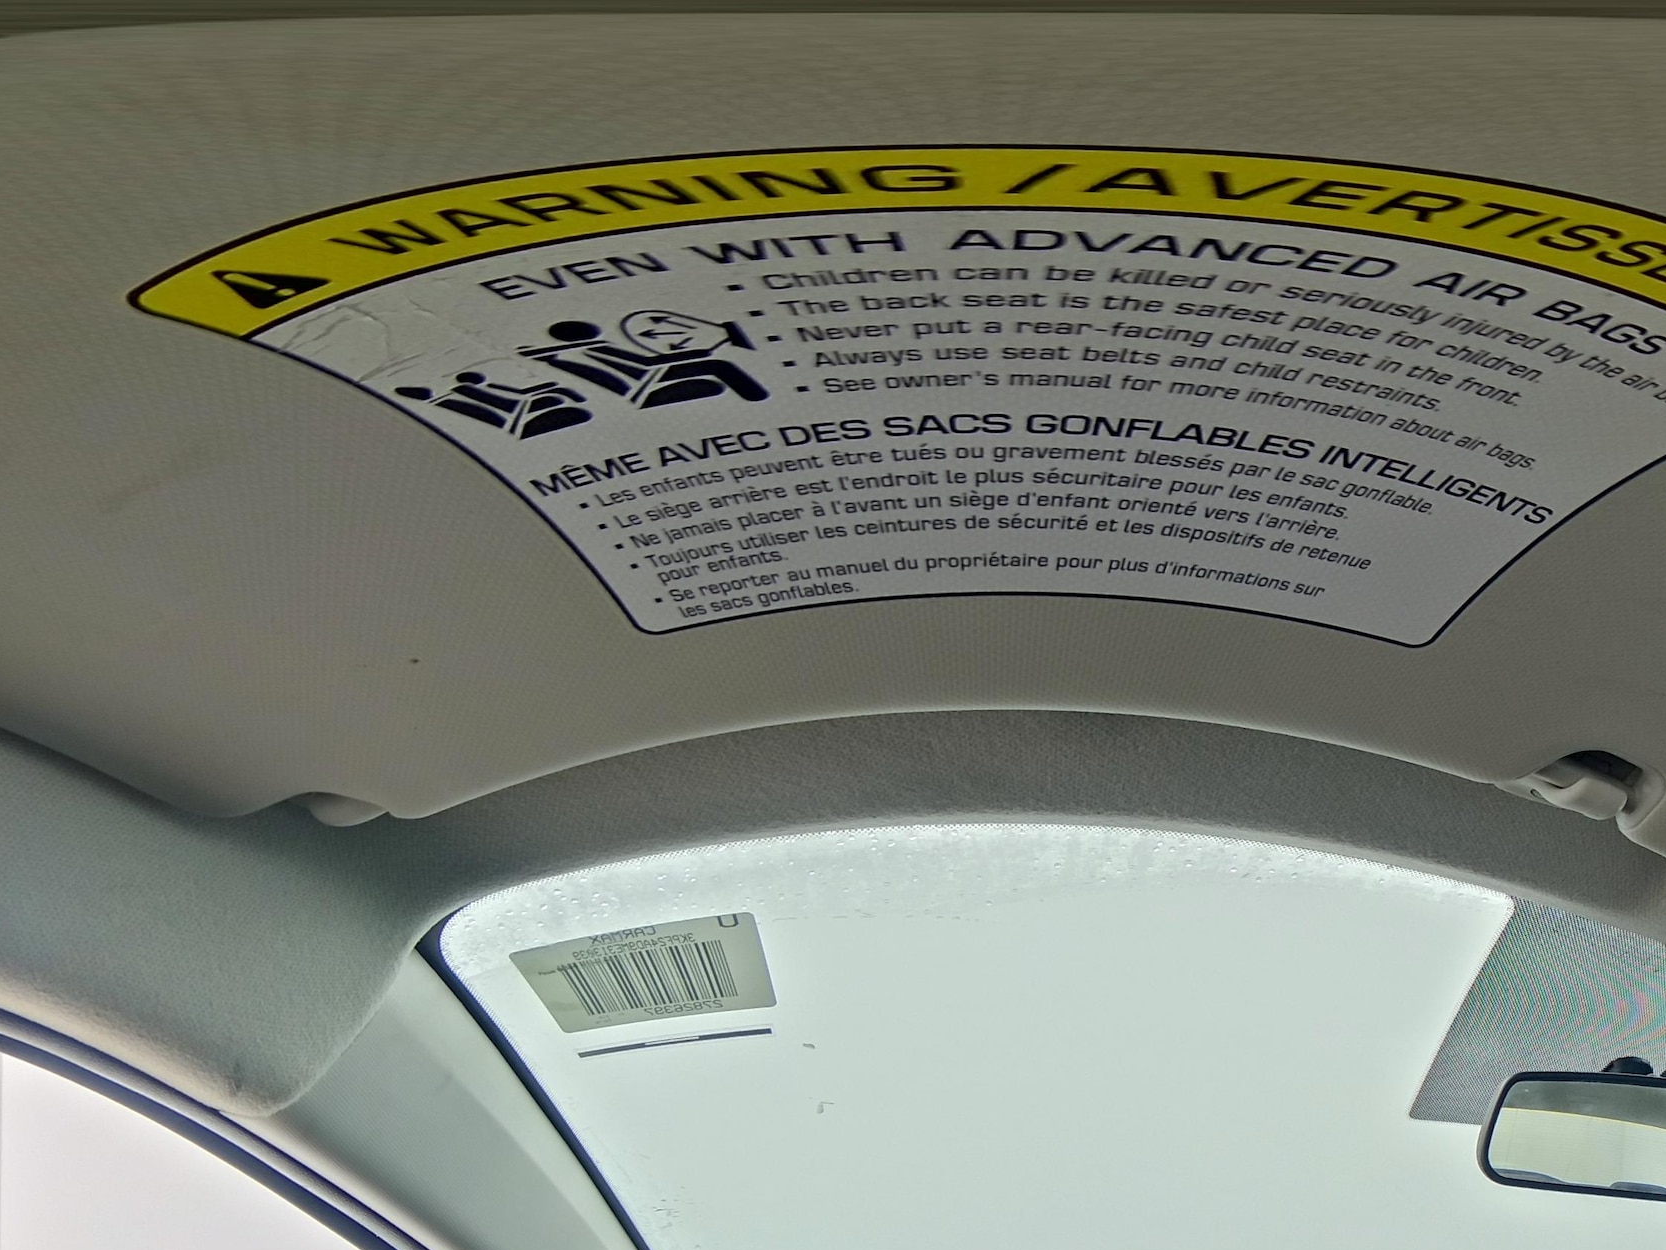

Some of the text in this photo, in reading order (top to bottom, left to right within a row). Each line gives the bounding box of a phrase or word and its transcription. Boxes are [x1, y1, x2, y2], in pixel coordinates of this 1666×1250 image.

[326, 164, 963, 256] WARNING
[477, 252, 671, 301] EVEN
[681, 231, 906, 265] WITH
[946, 229, 1399, 279] ADVANCED
[1411, 271, 1528, 307] AIR
[760, 268, 939, 291] Children
[951, 267, 1029, 281] can
[1043, 265, 1097, 282] be
[1107, 267, 1219, 290] killed
[1223, 279, 1273, 295] or
[1277, 286, 1443, 326] seriously
[1439, 313, 1551, 351] injured
[1542, 342, 1584, 364] by
[1578, 355, 1626, 379] the
[1620, 374, 1660, 391] air
[775, 292, 1544, 384] The back seat is the safest place for children.
[794, 319, 1522, 407] Never put a rear-facing child seat in the front.
[814, 345, 1441, 412] Always use seat belts and child restraints.
[821, 370, 1537, 470] See owner's manual for more information about air bags.
[528, 413, 1554, 525] MÊME AVEC DES SACS GONFLABLES INTELLIGENTS
[594, 442, 1433, 515] Les enfants peuvent être tués ou gravement blessés par le sac gonflable.
[668, 551, 1326, 603] Se reporter au manuel du propriétaire pour plus d'informations sur
[677, 581, 860, 619] les sacs gonflables.
